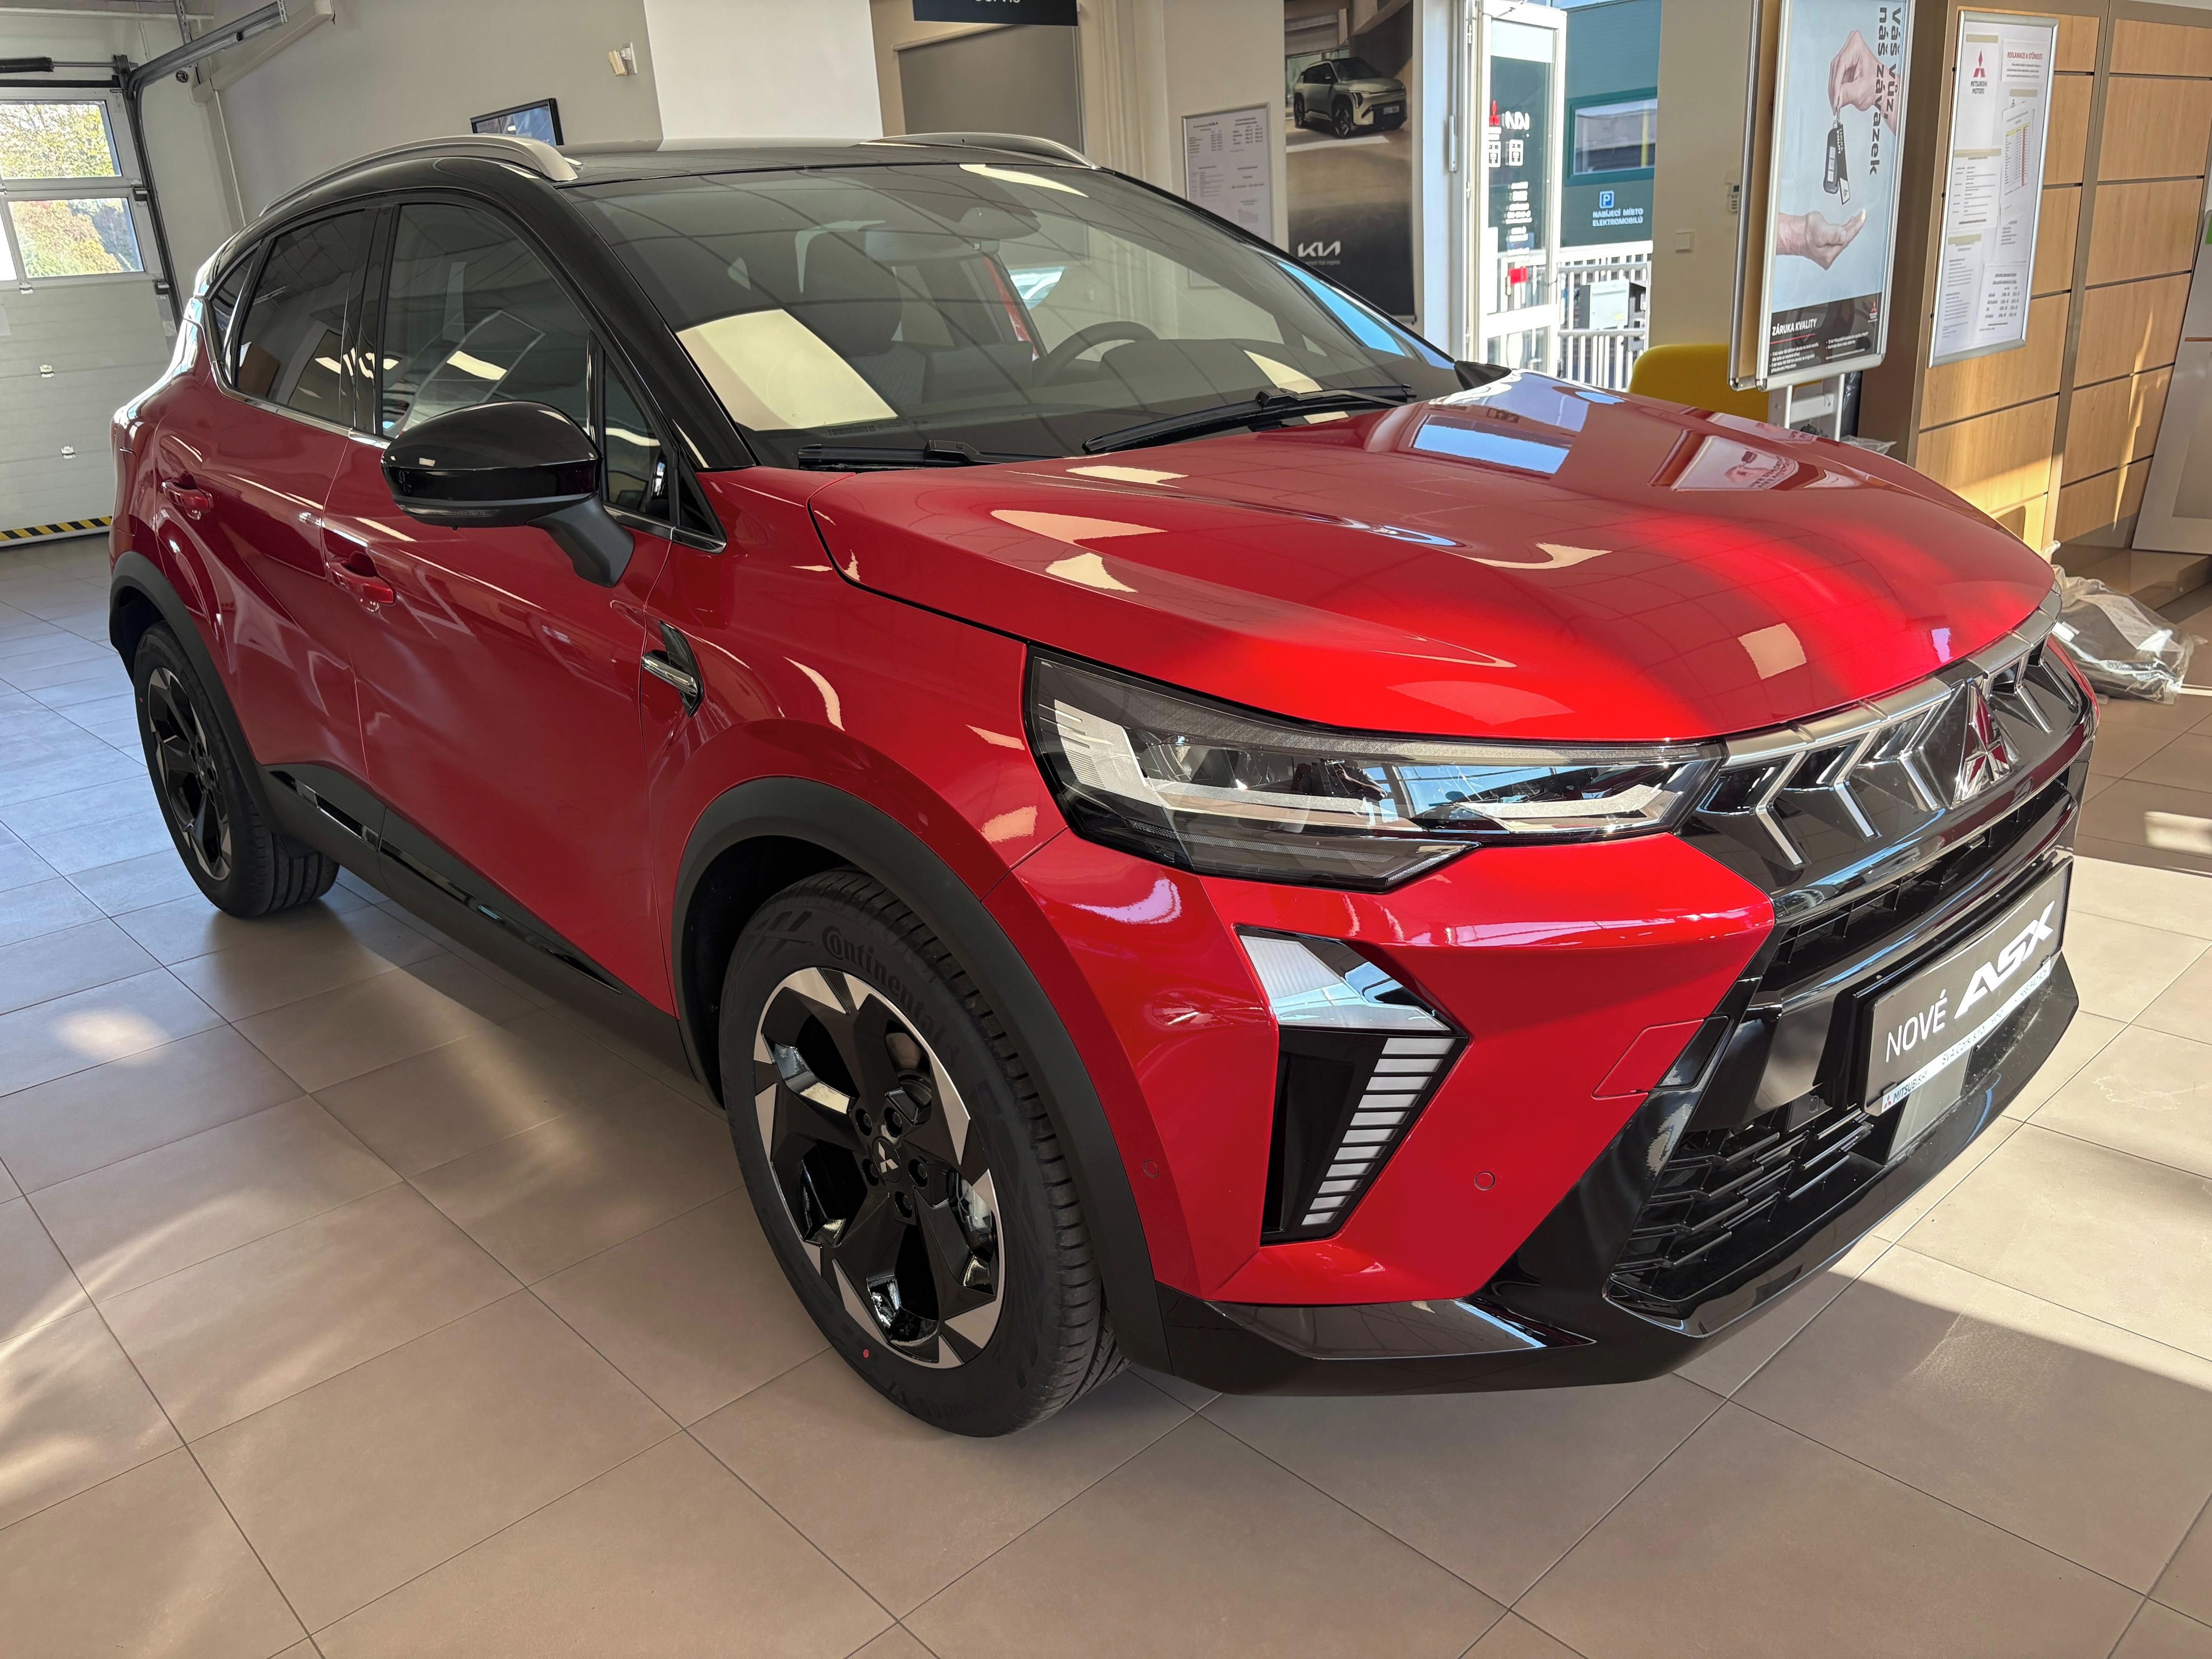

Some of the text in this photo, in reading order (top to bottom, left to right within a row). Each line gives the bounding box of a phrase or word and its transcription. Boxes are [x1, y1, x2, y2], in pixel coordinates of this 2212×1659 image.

[1870, 7, 1889, 176] náš závazek
[1883, 6, 1901, 120] Váš vůz,
[1623, 207, 1644, 217] MÍSTO
[1297, 241, 1341, 257] KIA
[1772, 318, 1817, 336] ZÁRUKA KVALITY
[821, 925, 947, 1046] Continental
[1886, 900, 2055, 1062] NOVÉ ASX
[1893, 1070, 1927, 1103] MITSUBISHI
